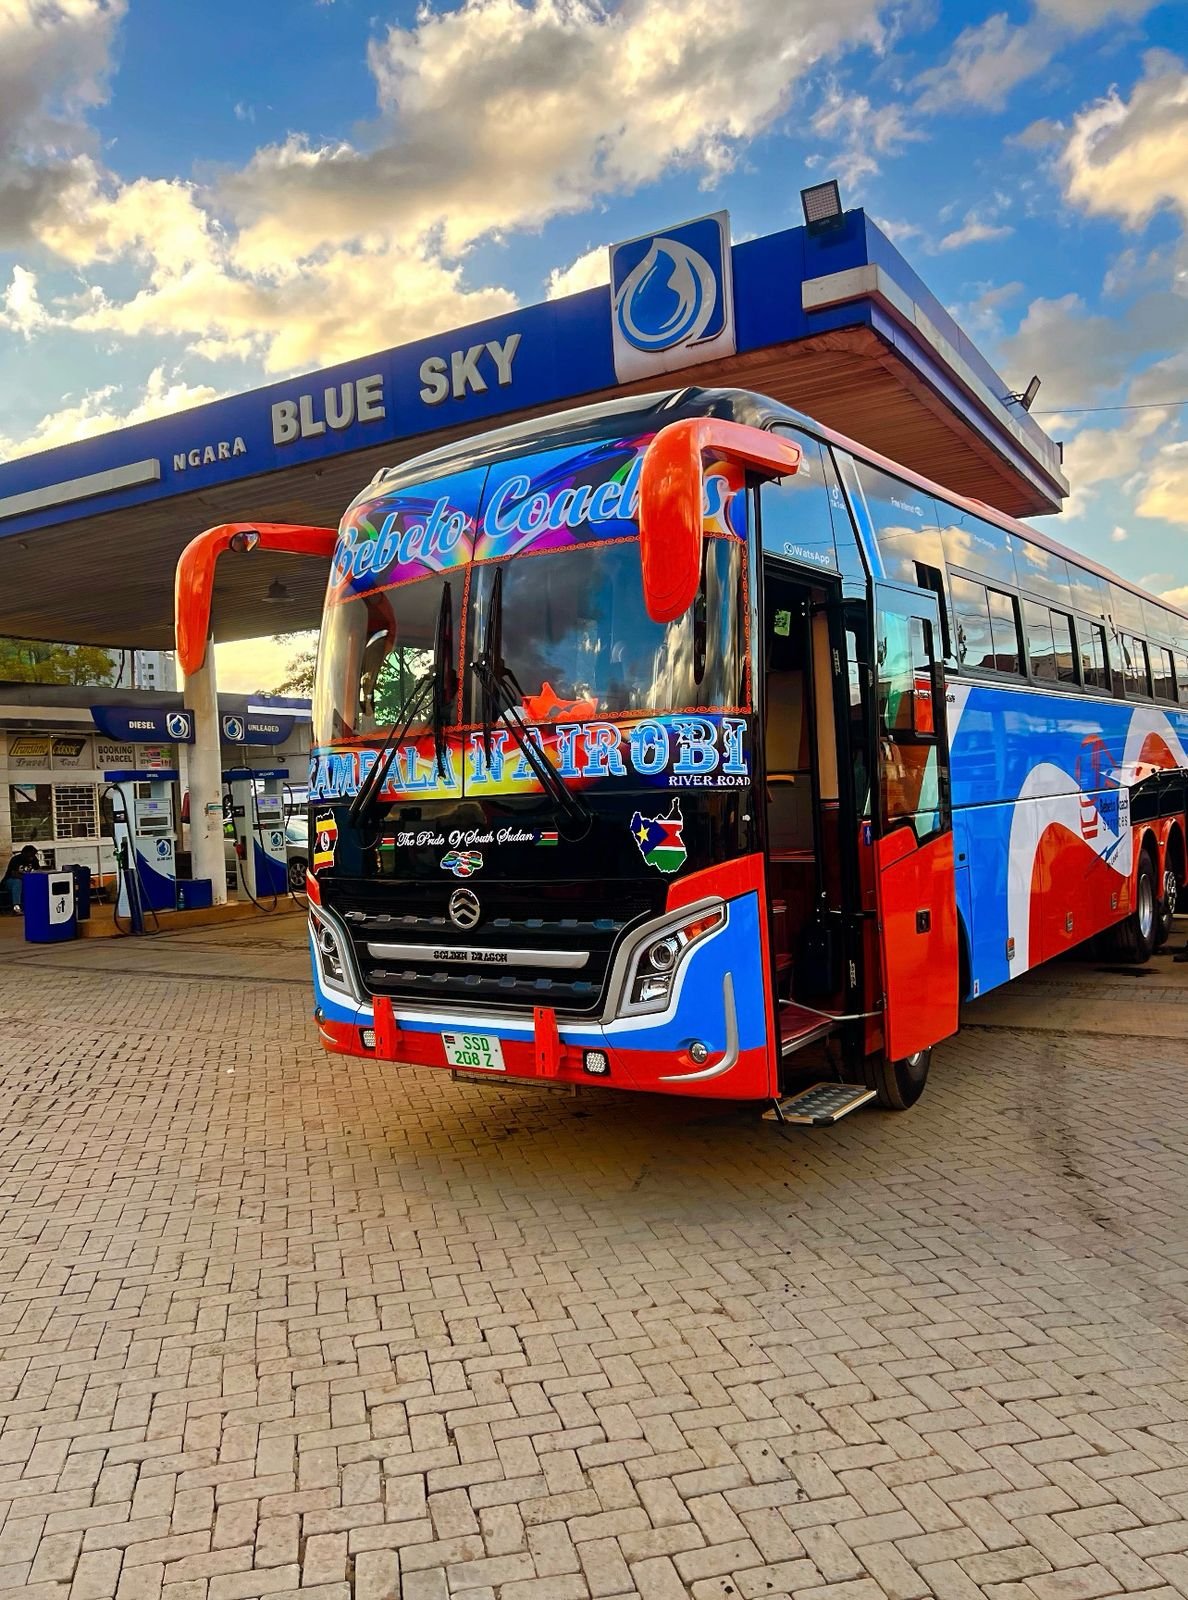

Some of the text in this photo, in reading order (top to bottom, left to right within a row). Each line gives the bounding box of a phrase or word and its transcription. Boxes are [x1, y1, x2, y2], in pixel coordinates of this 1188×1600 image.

[173, 333, 522, 472] NGARA BLUE SKY
[793, 543, 830, 565] WatsApp
[128, 721, 156, 730] DIESEL
[247, 724, 280, 733] UNLEADED
[98, 745, 132, 754] BOOKING
[469, 718, 748, 784] NAIROBI
[99, 755, 132, 763] & PARCEL
[668, 774, 750, 787] RIVER ROAD
[397, 827, 534, 849] The Pride Of South Sudan
[433, 951, 508, 963] GOLDEN DRAGON
[463, 1036, 490, 1051] SSD
[454, 1050, 494, 1067] 208 Z
